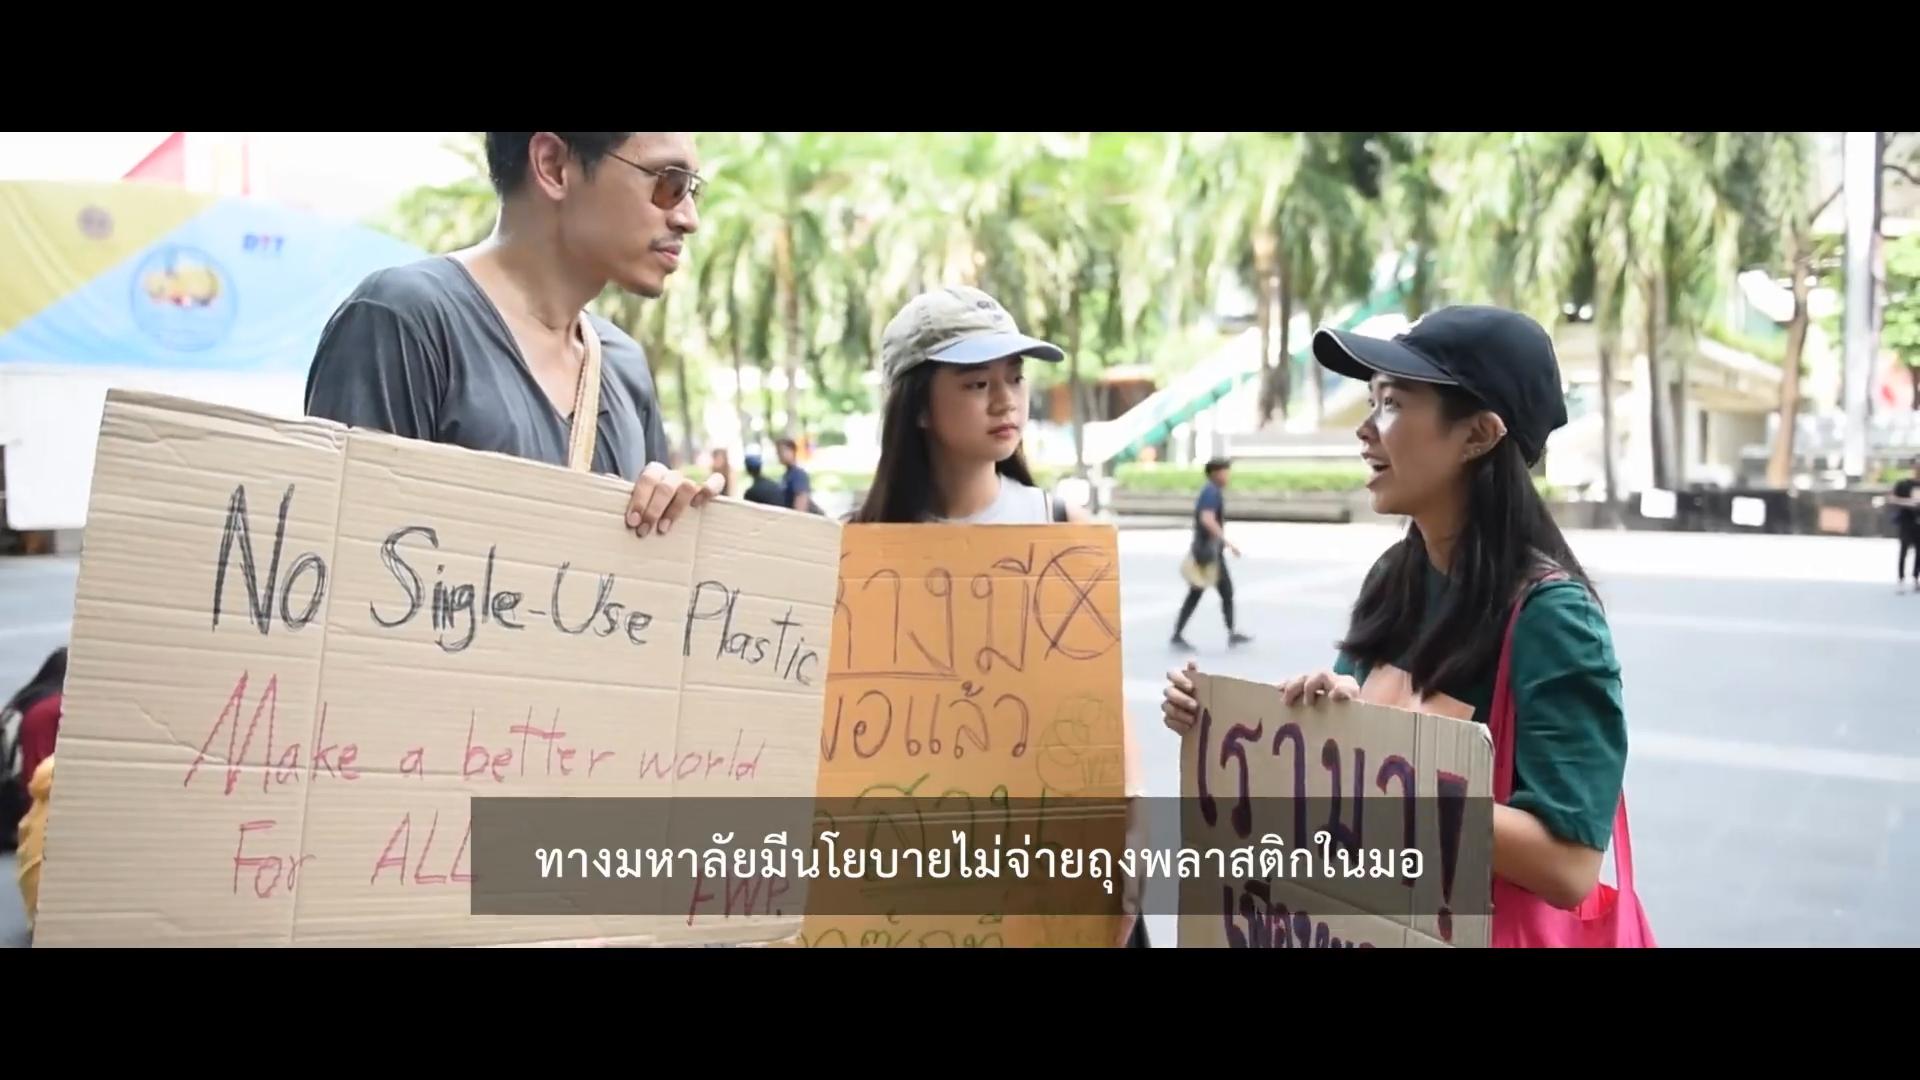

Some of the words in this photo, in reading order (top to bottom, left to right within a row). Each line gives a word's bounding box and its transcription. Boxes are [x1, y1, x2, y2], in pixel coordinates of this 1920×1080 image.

[212, 483, 328, 636] No
[681, 579, 819, 686] Plastic
[183, 670, 361, 796] Make
[399, 744, 424, 780] a
[462, 704, 616, 783] better
[638, 726, 767, 782] world
[232, 820, 316, 899] For
[369, 810, 480, 886] ALL
[1196, 707, 1469, 942] เรามา!
